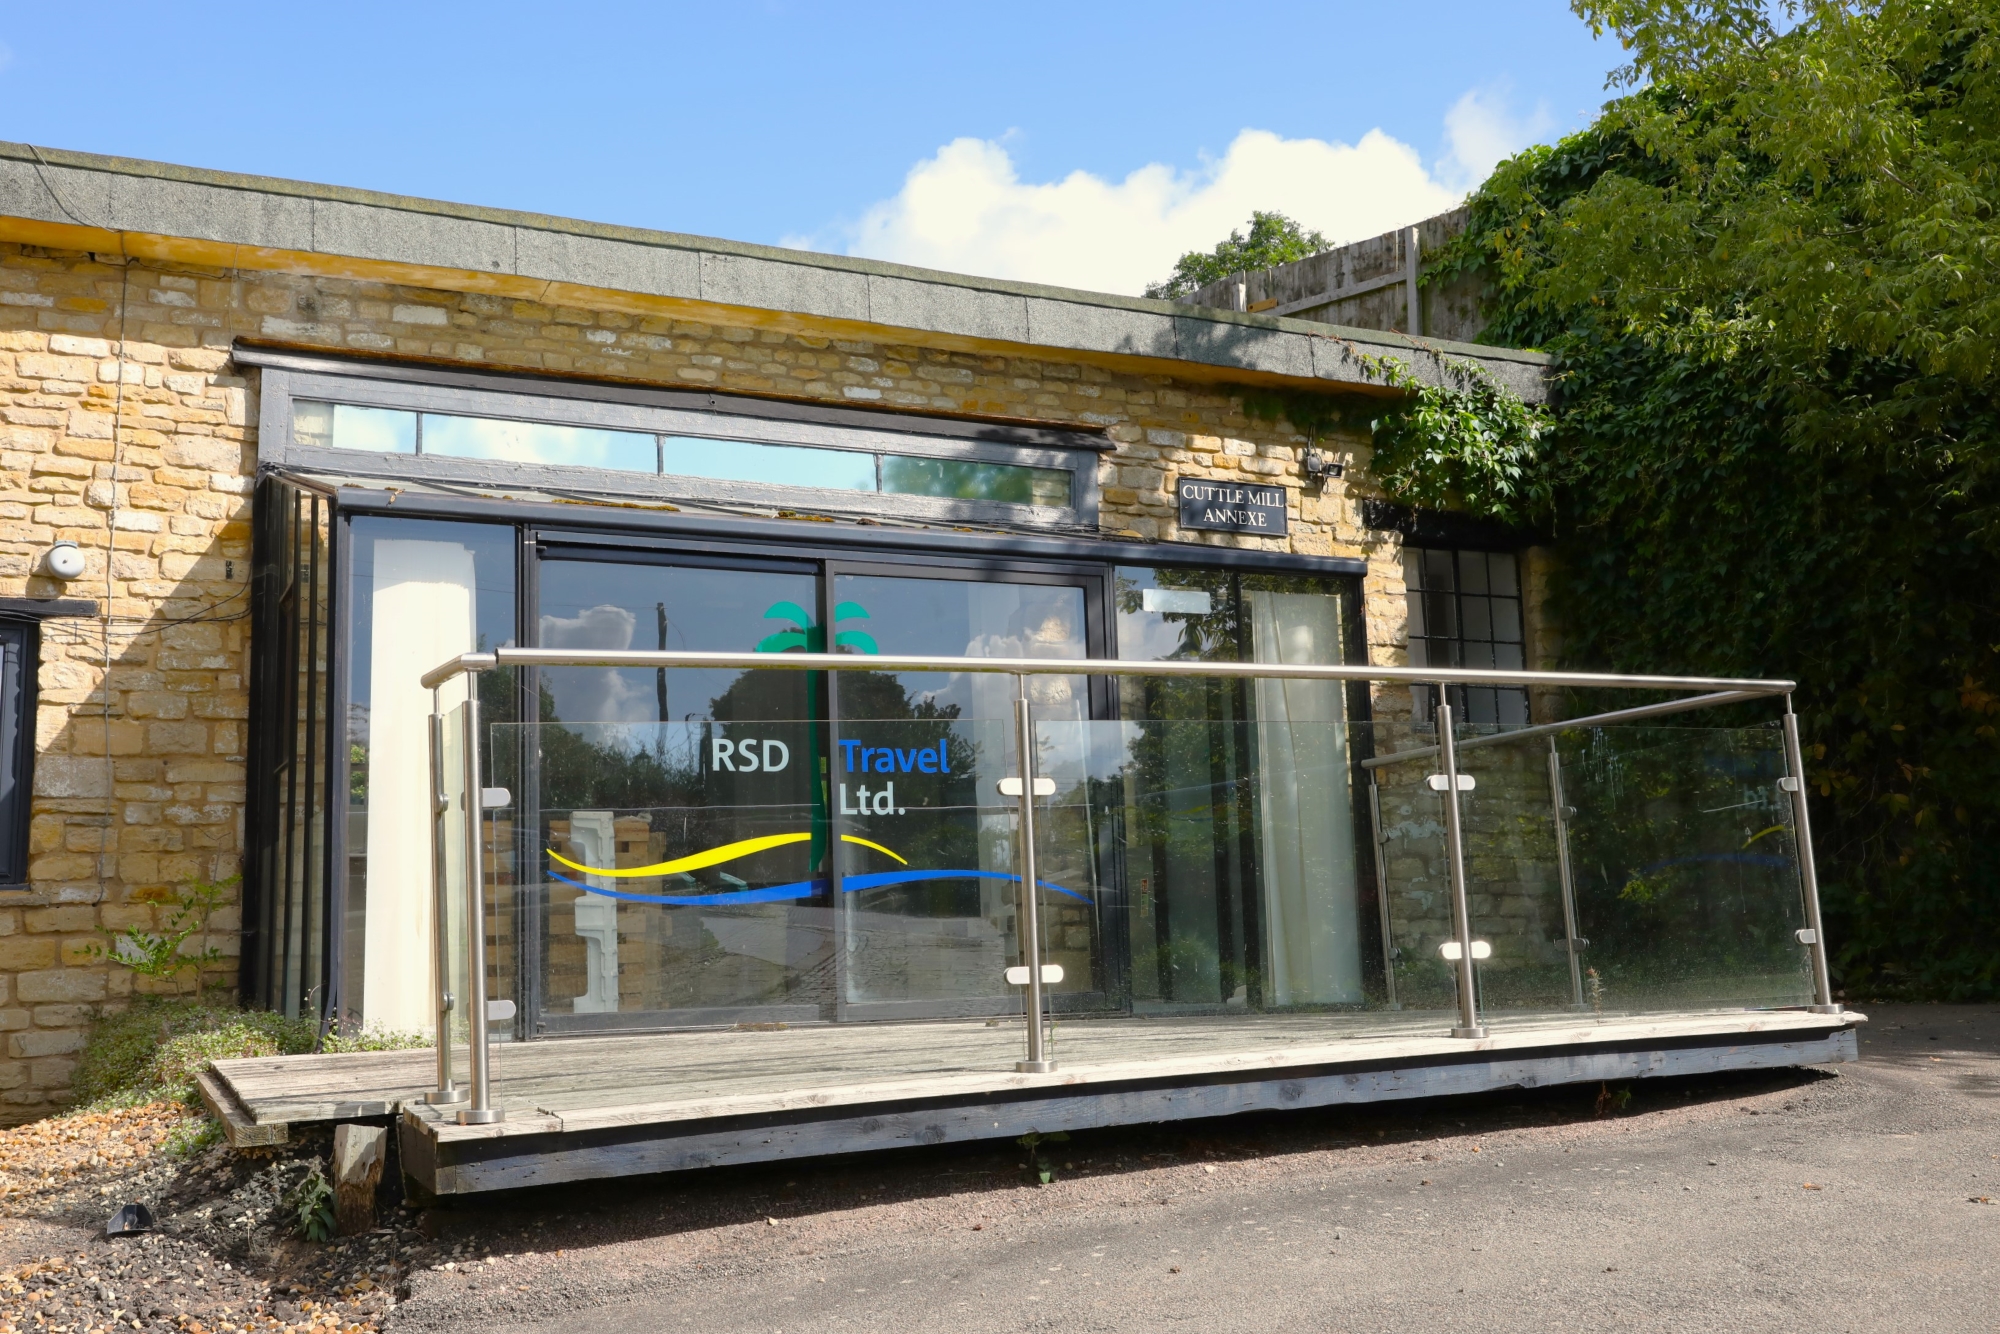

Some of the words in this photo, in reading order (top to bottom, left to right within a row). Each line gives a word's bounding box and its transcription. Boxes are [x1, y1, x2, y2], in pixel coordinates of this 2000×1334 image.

[1182, 484, 1245, 504] CUTTLE
[1247, 490, 1284, 508] MILL
[1203, 508, 1267, 527] ANNEXE
[712, 738, 790, 772] RSD
[838, 738, 950, 774] Travel
[838, 781, 906, 815] Ltd.
